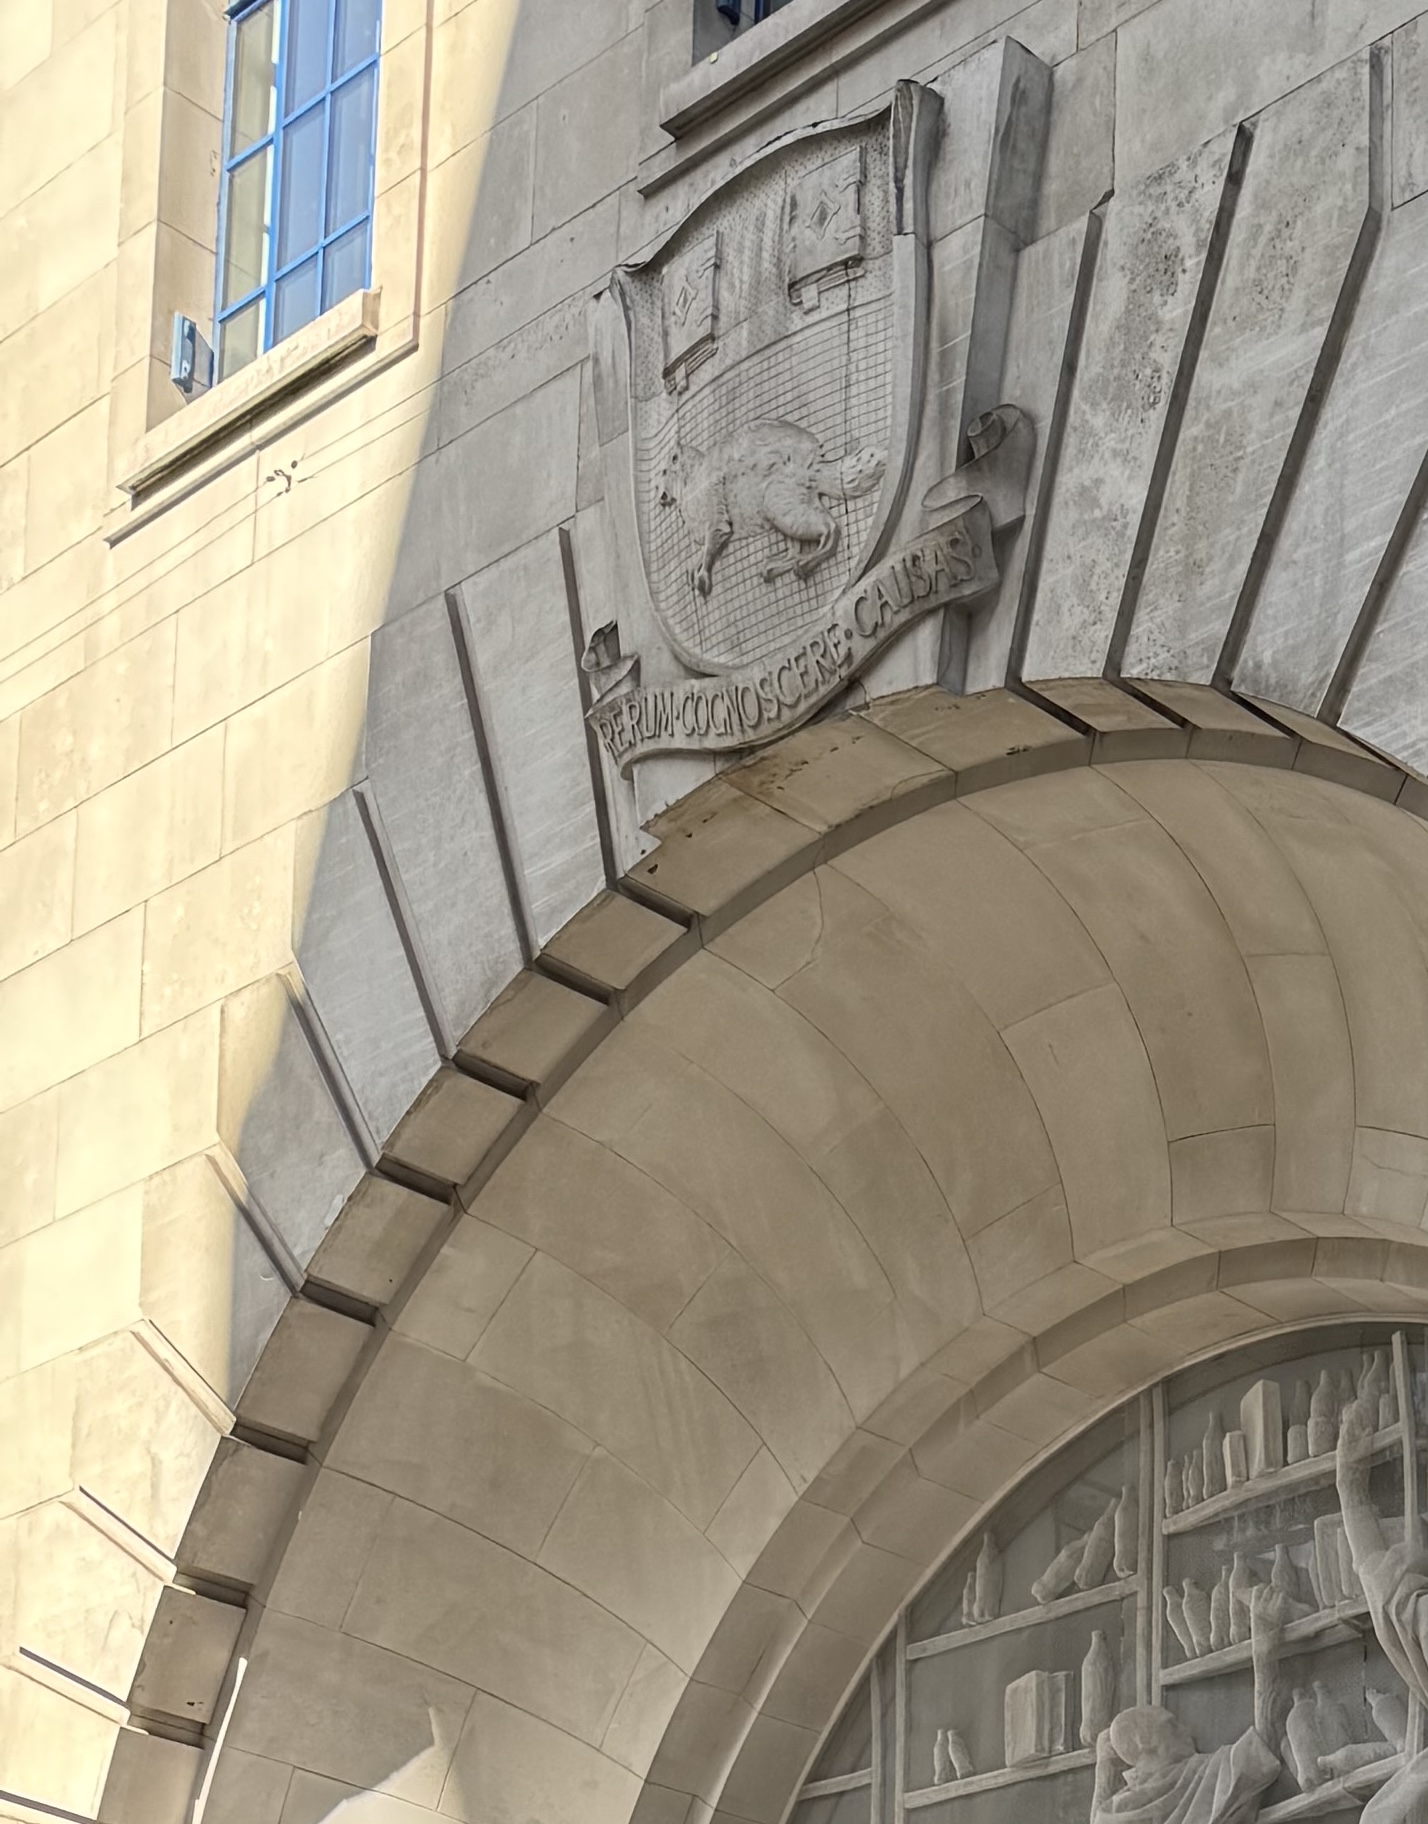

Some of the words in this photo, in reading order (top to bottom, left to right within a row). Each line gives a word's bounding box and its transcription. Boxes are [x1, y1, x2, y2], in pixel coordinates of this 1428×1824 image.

[600, 689, 675, 761] RERUM
[681, 622, 854, 736] COGNOSCERE
[853, 529, 975, 638] CAUSAS
